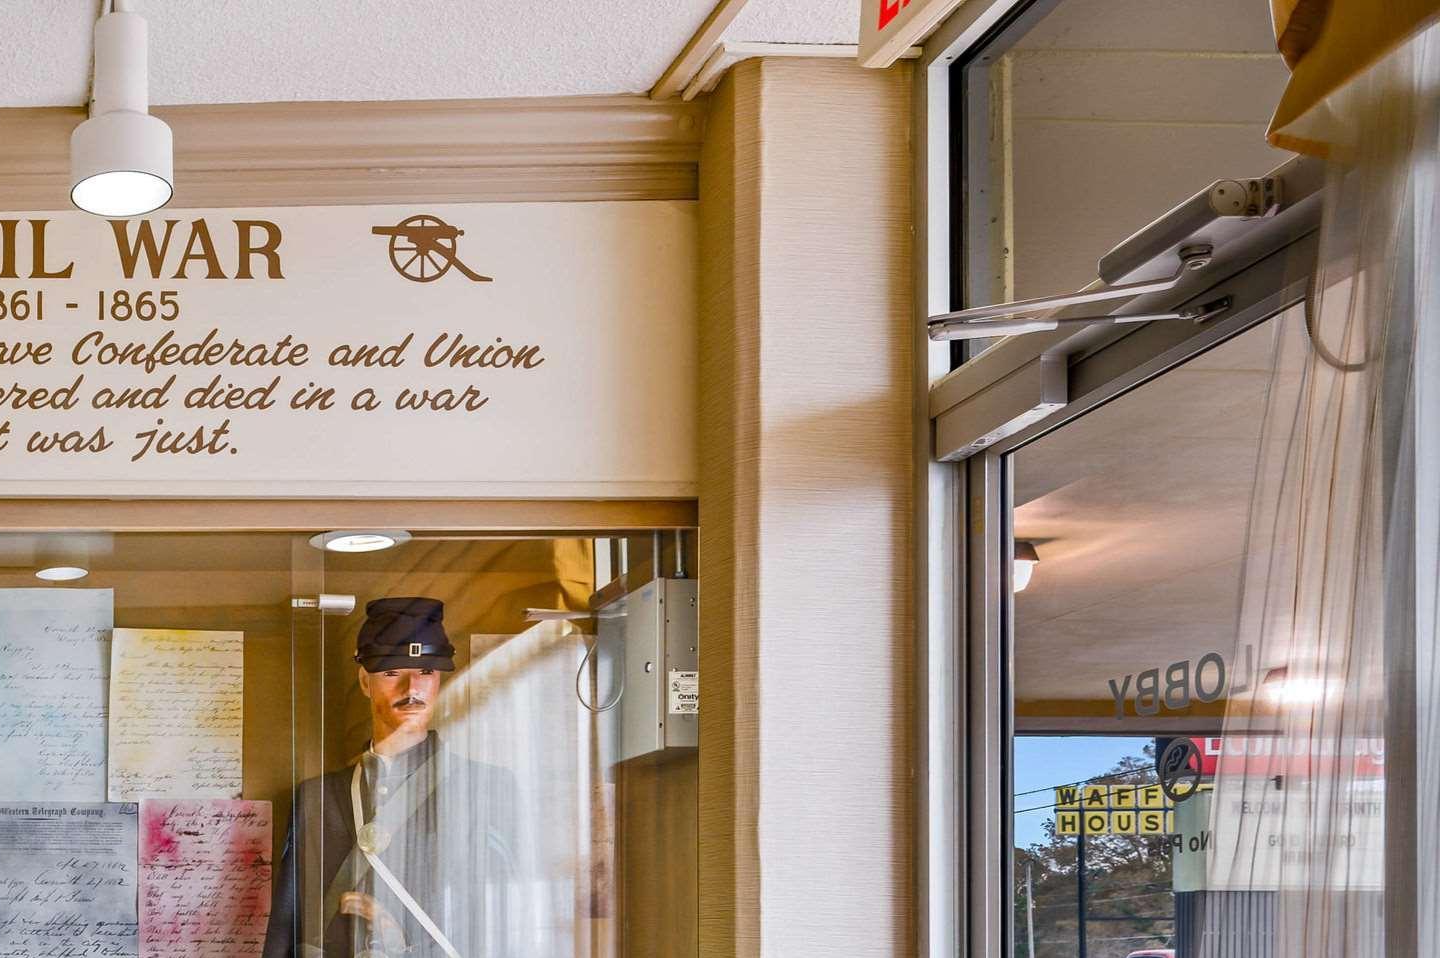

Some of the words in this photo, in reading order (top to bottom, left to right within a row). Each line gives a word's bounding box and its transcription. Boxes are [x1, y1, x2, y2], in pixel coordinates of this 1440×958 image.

[112, 218, 286, 280] WAR
[98, 289, 180, 322] 1865
[71, 331, 315, 373] Confederate
[328, 332, 415, 368] and
[423, 332, 546, 370] Union
[91, 374, 177, 410] and
[183, 374, 282, 411] died
[289, 382, 336, 411] in
[350, 387, 382, 412] a
[395, 384, 490, 412] war
[26, 426, 115, 454] was
[133, 419, 238, 461] just.
[1060, 787, 1159, 806] WAFF
[1061, 814, 1160, 832] HOUS
